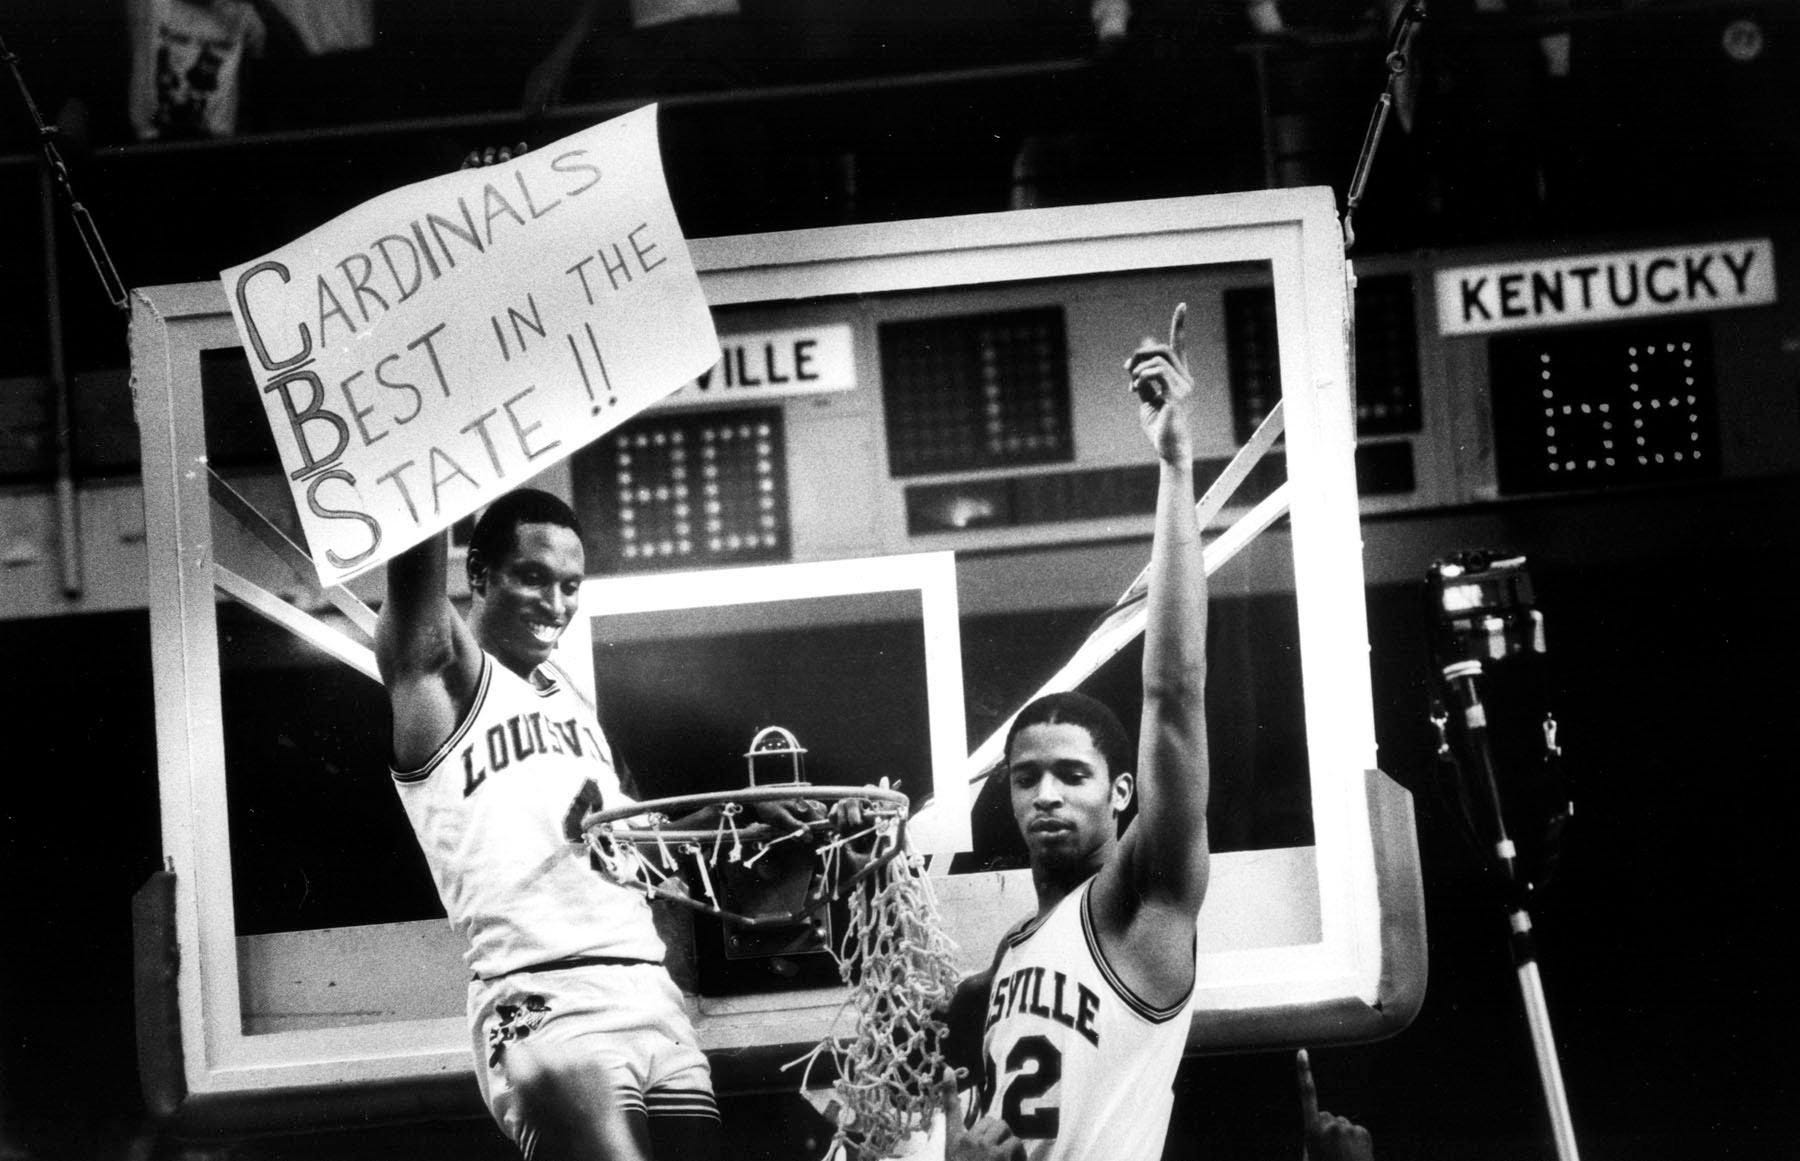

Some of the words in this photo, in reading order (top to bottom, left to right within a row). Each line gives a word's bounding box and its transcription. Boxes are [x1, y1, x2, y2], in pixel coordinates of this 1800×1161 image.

[235, 149, 601, 372] CARDINALS
[263, 323, 446, 481] BEST
[491, 293, 547, 362] IN
[565, 223, 667, 305] THE
[1460, 250, 1756, 322] KENTUCKY
[305, 385, 562, 570] STATE
[615, 422, 778, 561] 80
